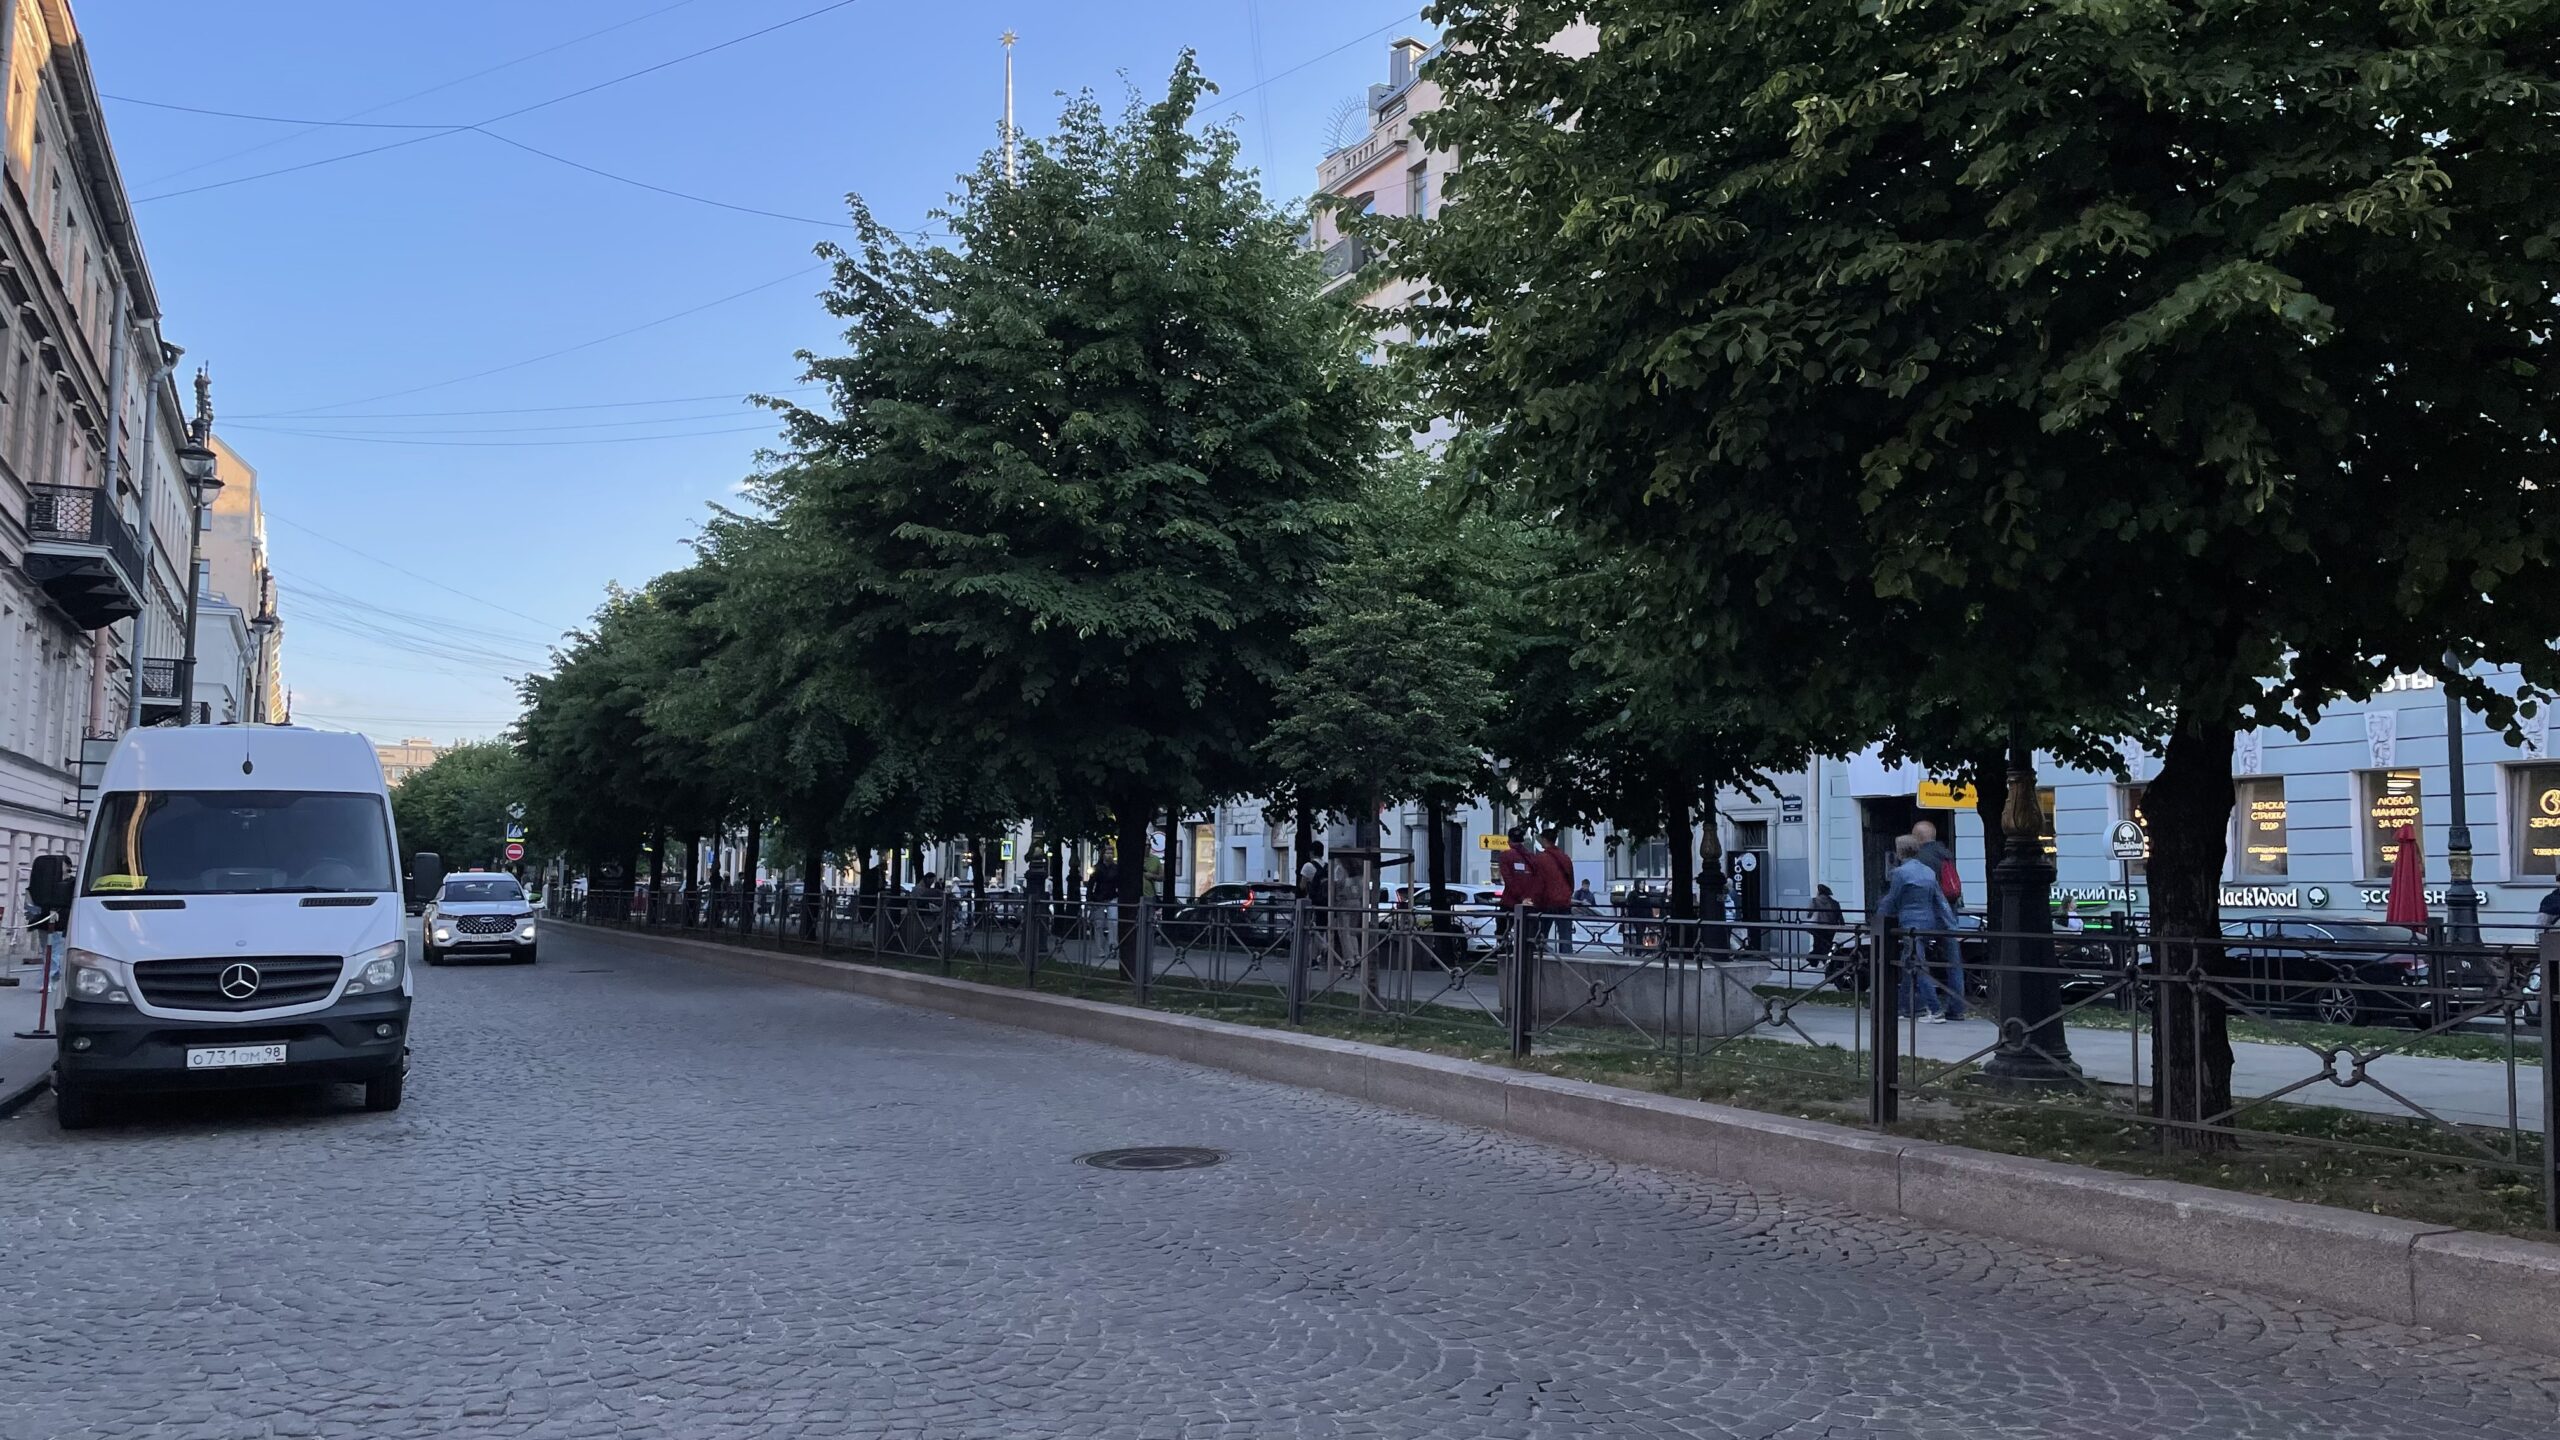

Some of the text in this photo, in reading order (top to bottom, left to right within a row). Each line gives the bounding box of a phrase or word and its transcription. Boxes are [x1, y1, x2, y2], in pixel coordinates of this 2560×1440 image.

[2377, 795, 2414, 806] ЛЮБОЙ
[2251, 811, 2287, 820] СТРИЖКА
[2371, 807, 2420, 818] МАНИКЮР
[2378, 818, 2391, 828] ЗА
[2108, 889, 2137, 901] ПАБ
[2218, 887, 2298, 907] lackWood
[265, 1047, 281, 1057] 98
